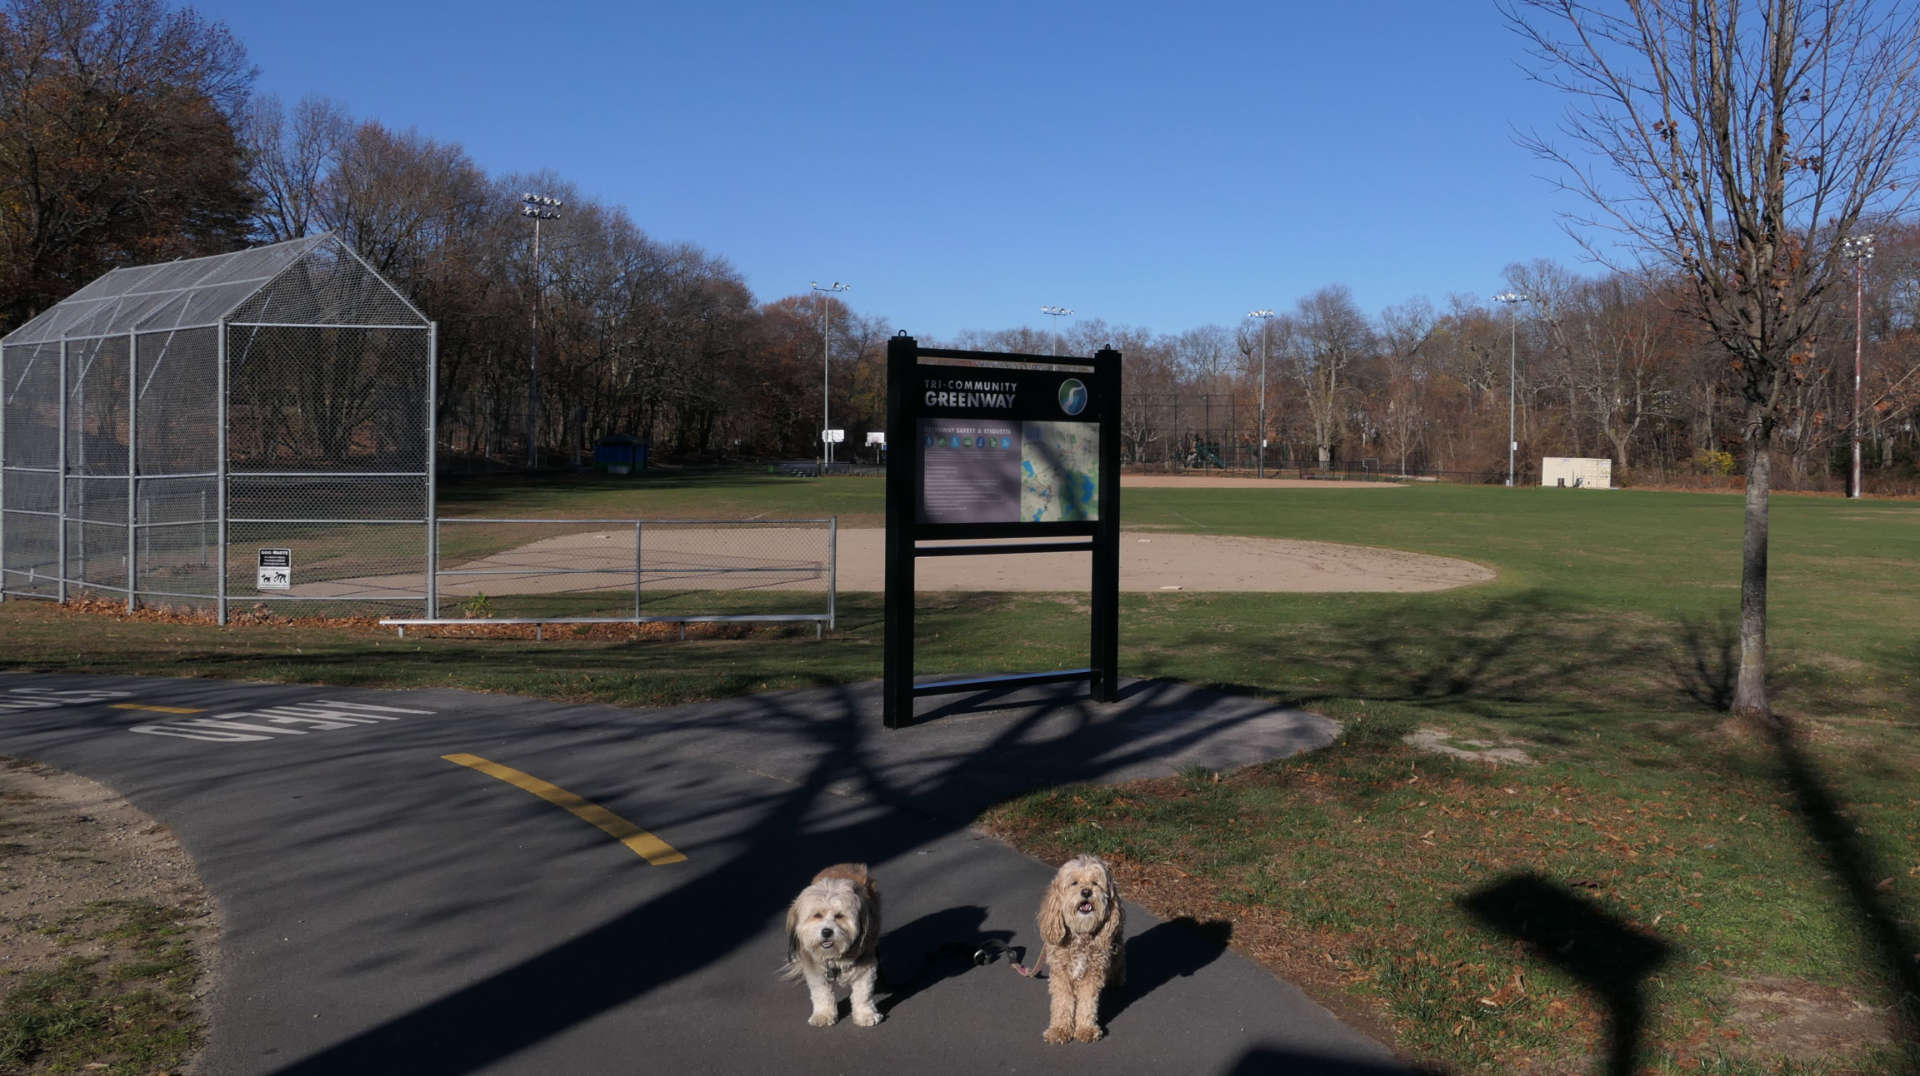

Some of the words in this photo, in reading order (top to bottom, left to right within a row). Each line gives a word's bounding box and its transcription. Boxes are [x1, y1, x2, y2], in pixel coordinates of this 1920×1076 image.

[924, 379, 1017, 392] TRI-COMMUNITY
[925, 390, 1016, 408] GREENWAY
[128, 699, 437, 743] AHEAD
